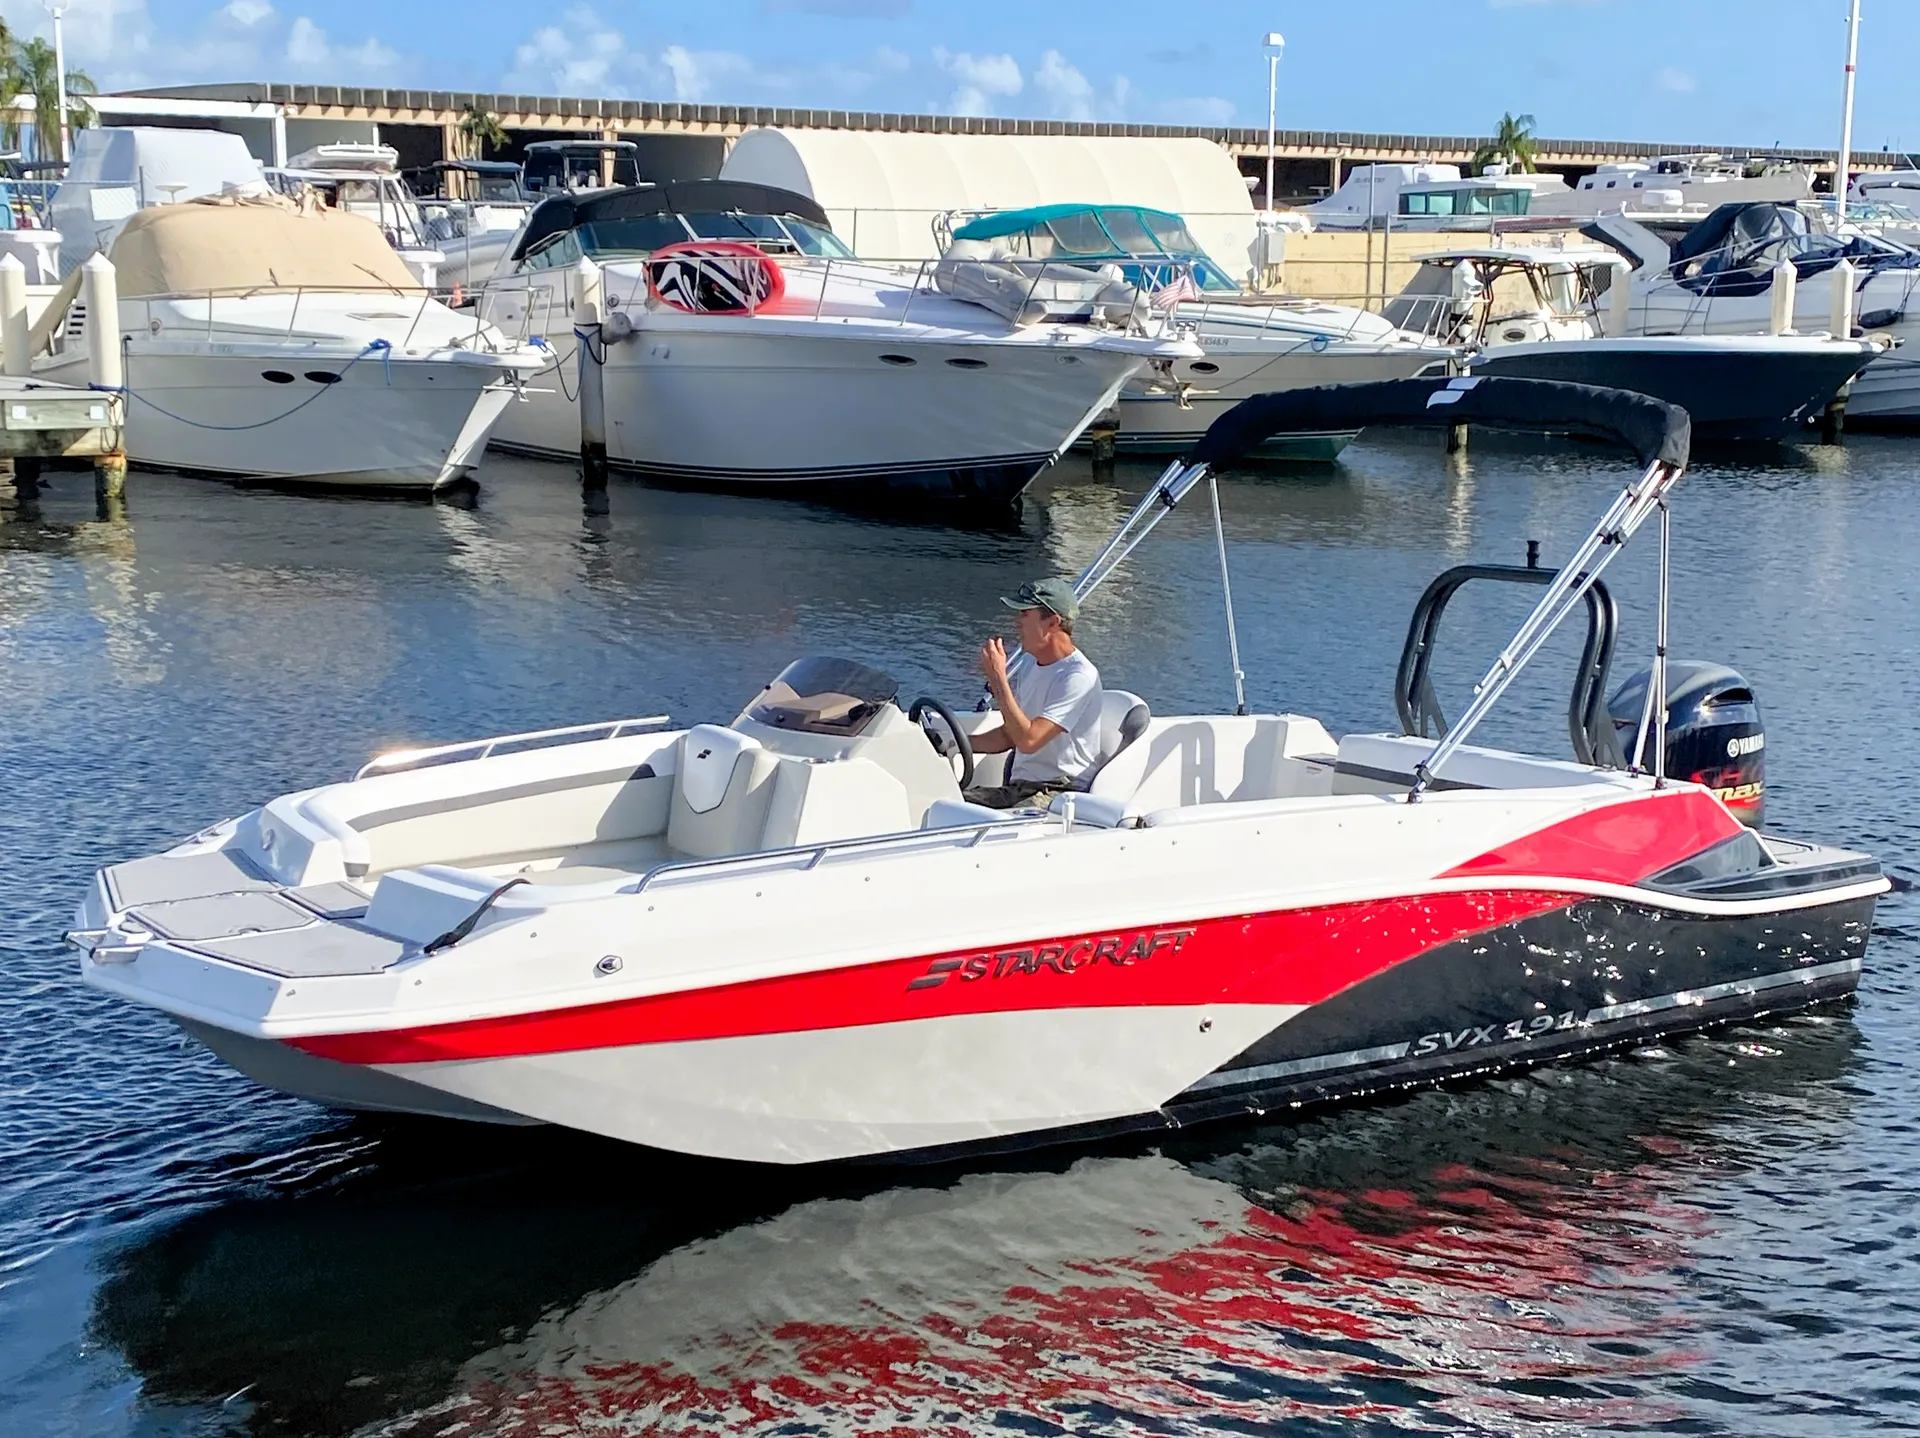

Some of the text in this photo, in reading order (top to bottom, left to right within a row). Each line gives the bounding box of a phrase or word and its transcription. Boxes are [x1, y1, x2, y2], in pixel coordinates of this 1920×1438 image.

[1739, 733, 1764, 754] YAMAH
[961, 928, 1197, 982] STARCRAFT
[1413, 1010, 1577, 1056] SVX 191
